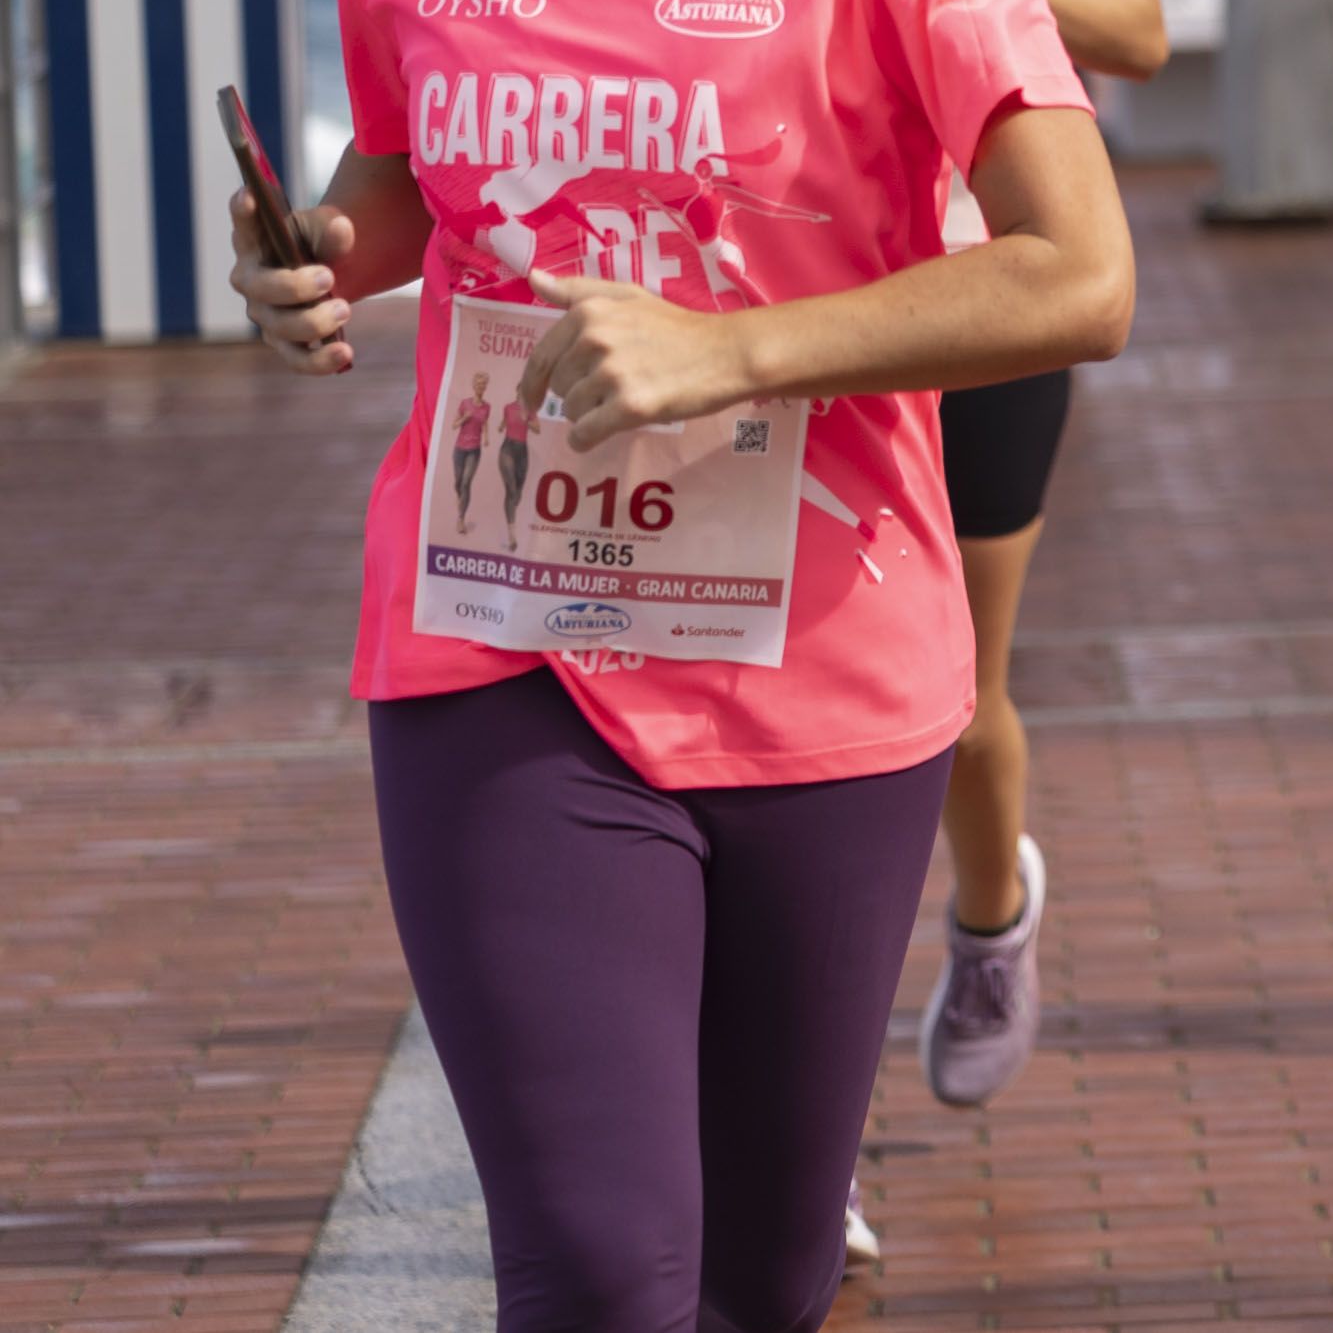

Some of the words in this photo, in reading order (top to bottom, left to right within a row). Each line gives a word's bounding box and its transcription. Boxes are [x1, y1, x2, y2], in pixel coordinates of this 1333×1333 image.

[418, 71, 729, 176] CARRERA
[576, 203, 689, 299] DE
[478, 319, 493, 332] TU
[535, 469, 676, 533] 016
[568, 539, 635, 567] 1365
[435, 553, 507, 580] CARRERA
[510, 567, 525, 585] DE
[530, 569, 552, 589] LA
[558, 573, 620, 595] MUJER
[636, 583, 686, 600] GRAN
[691, 582, 769, 602] CANARIA
[456, 602, 505, 626] OYSHO
[553, 613, 624, 629] ASTURIANA
[686, 623, 745, 639] Santander
